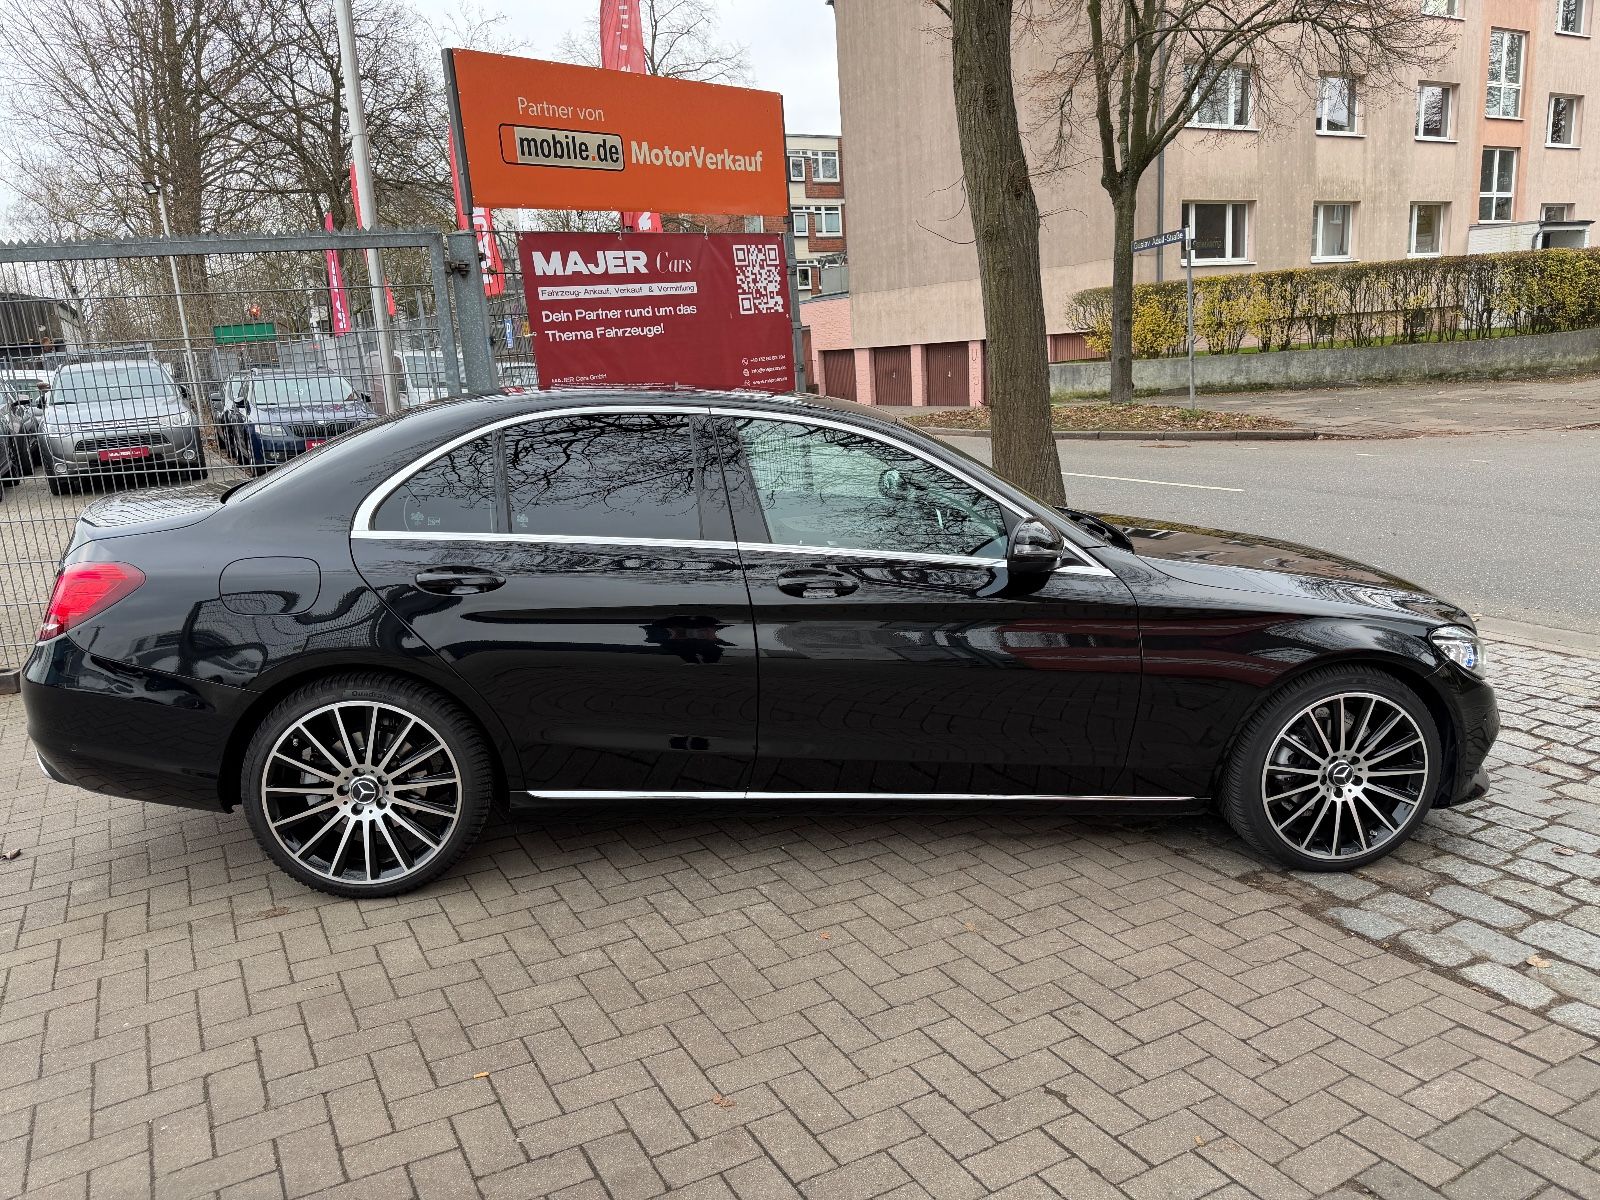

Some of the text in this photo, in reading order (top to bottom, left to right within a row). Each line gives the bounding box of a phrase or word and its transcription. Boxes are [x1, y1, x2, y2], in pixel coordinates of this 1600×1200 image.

[517, 96, 605, 122] Partner von
[518, 133, 763, 172] mobile.de MotorVerkauf
[531, 250, 693, 276] MAJER Cars
[648, 285, 655, 293] &
[541, 303, 697, 323] Dein Partner rund um das
[545, 322, 665, 342] Thema Fahrzeuge!
